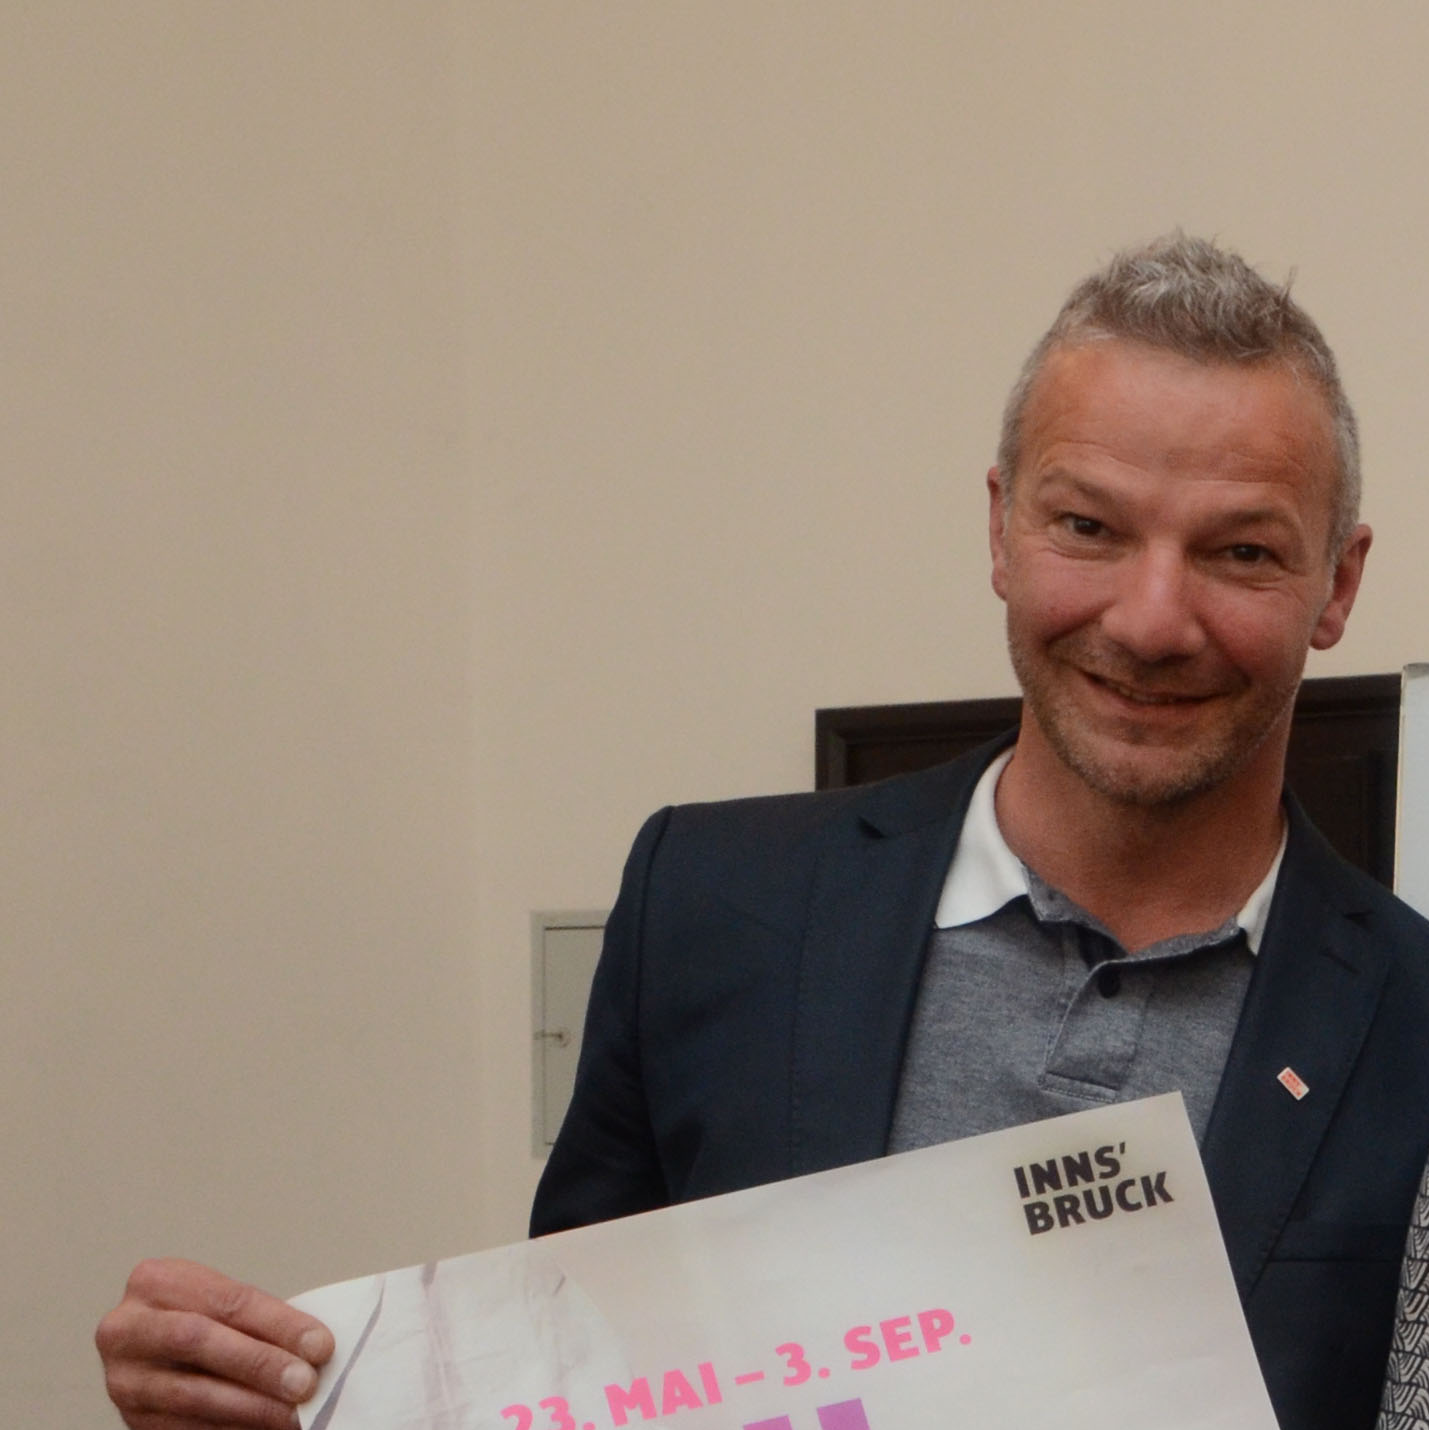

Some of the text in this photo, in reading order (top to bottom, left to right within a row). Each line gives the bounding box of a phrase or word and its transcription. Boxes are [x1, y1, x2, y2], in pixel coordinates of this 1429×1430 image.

[1013, 1142, 1129, 1199] INNS'
[1022, 1171, 1175, 1236] BRUCK
[603, 1362, 724, 1427] MAI
[775, 1342, 831, 1388] 3.
[843, 1308, 973, 1371] SEP.
